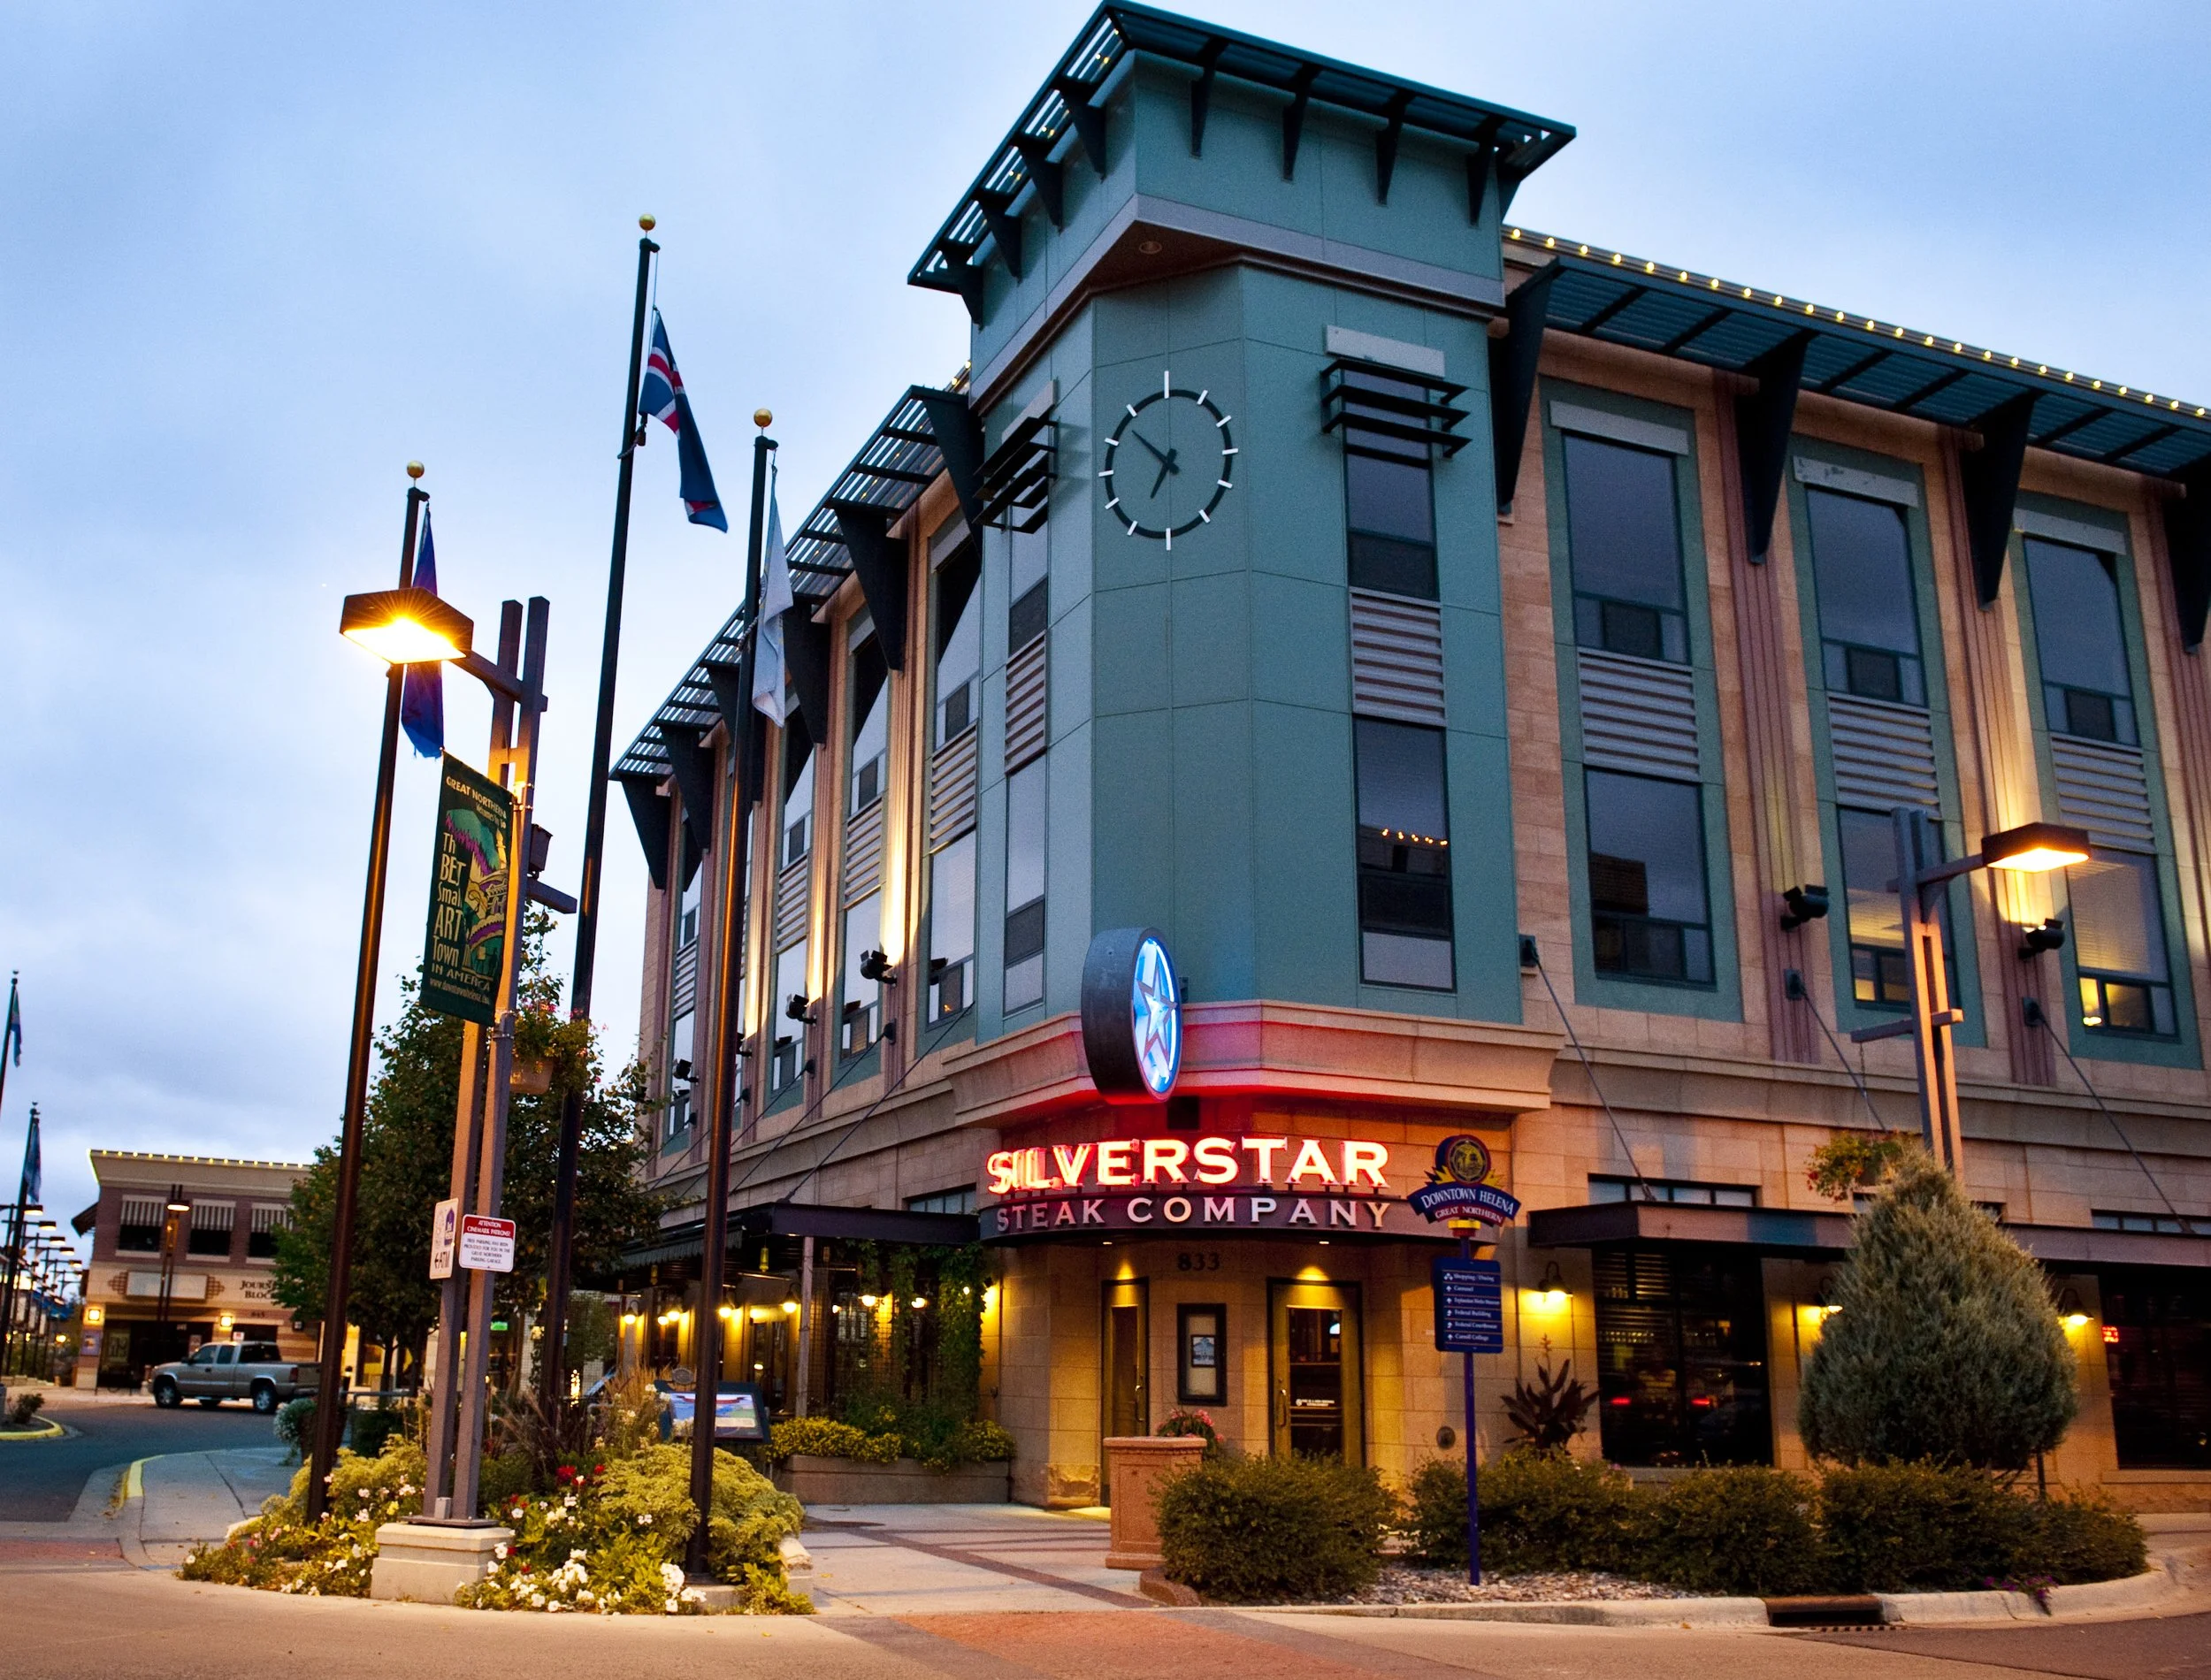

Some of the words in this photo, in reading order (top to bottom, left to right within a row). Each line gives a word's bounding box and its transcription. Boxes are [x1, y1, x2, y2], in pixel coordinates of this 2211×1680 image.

[446, 776, 471, 796] GREAT
[472, 789, 507, 819] NORTHERN
[433, 904, 464, 942] ART
[432, 935, 460, 967] Town
[431, 963, 444, 975] IN
[987, 1137, 1390, 1194] SILVERSTAR
[997, 1198, 1106, 1232] STEAK
[1127, 1196, 1391, 1229] COMPANY
[1420, 1187, 1477, 1209] DOWNTOWN
[1479, 1190, 1516, 1215] HELENA
[1434, 1206, 1459, 1218] GREAT
[1462, 1206, 1503, 1223] NORTHERN
[1177, 1252, 1220, 1271] 833
[240, 1280, 273, 1290] JOURN
[244, 1290, 272, 1299] BLOC
